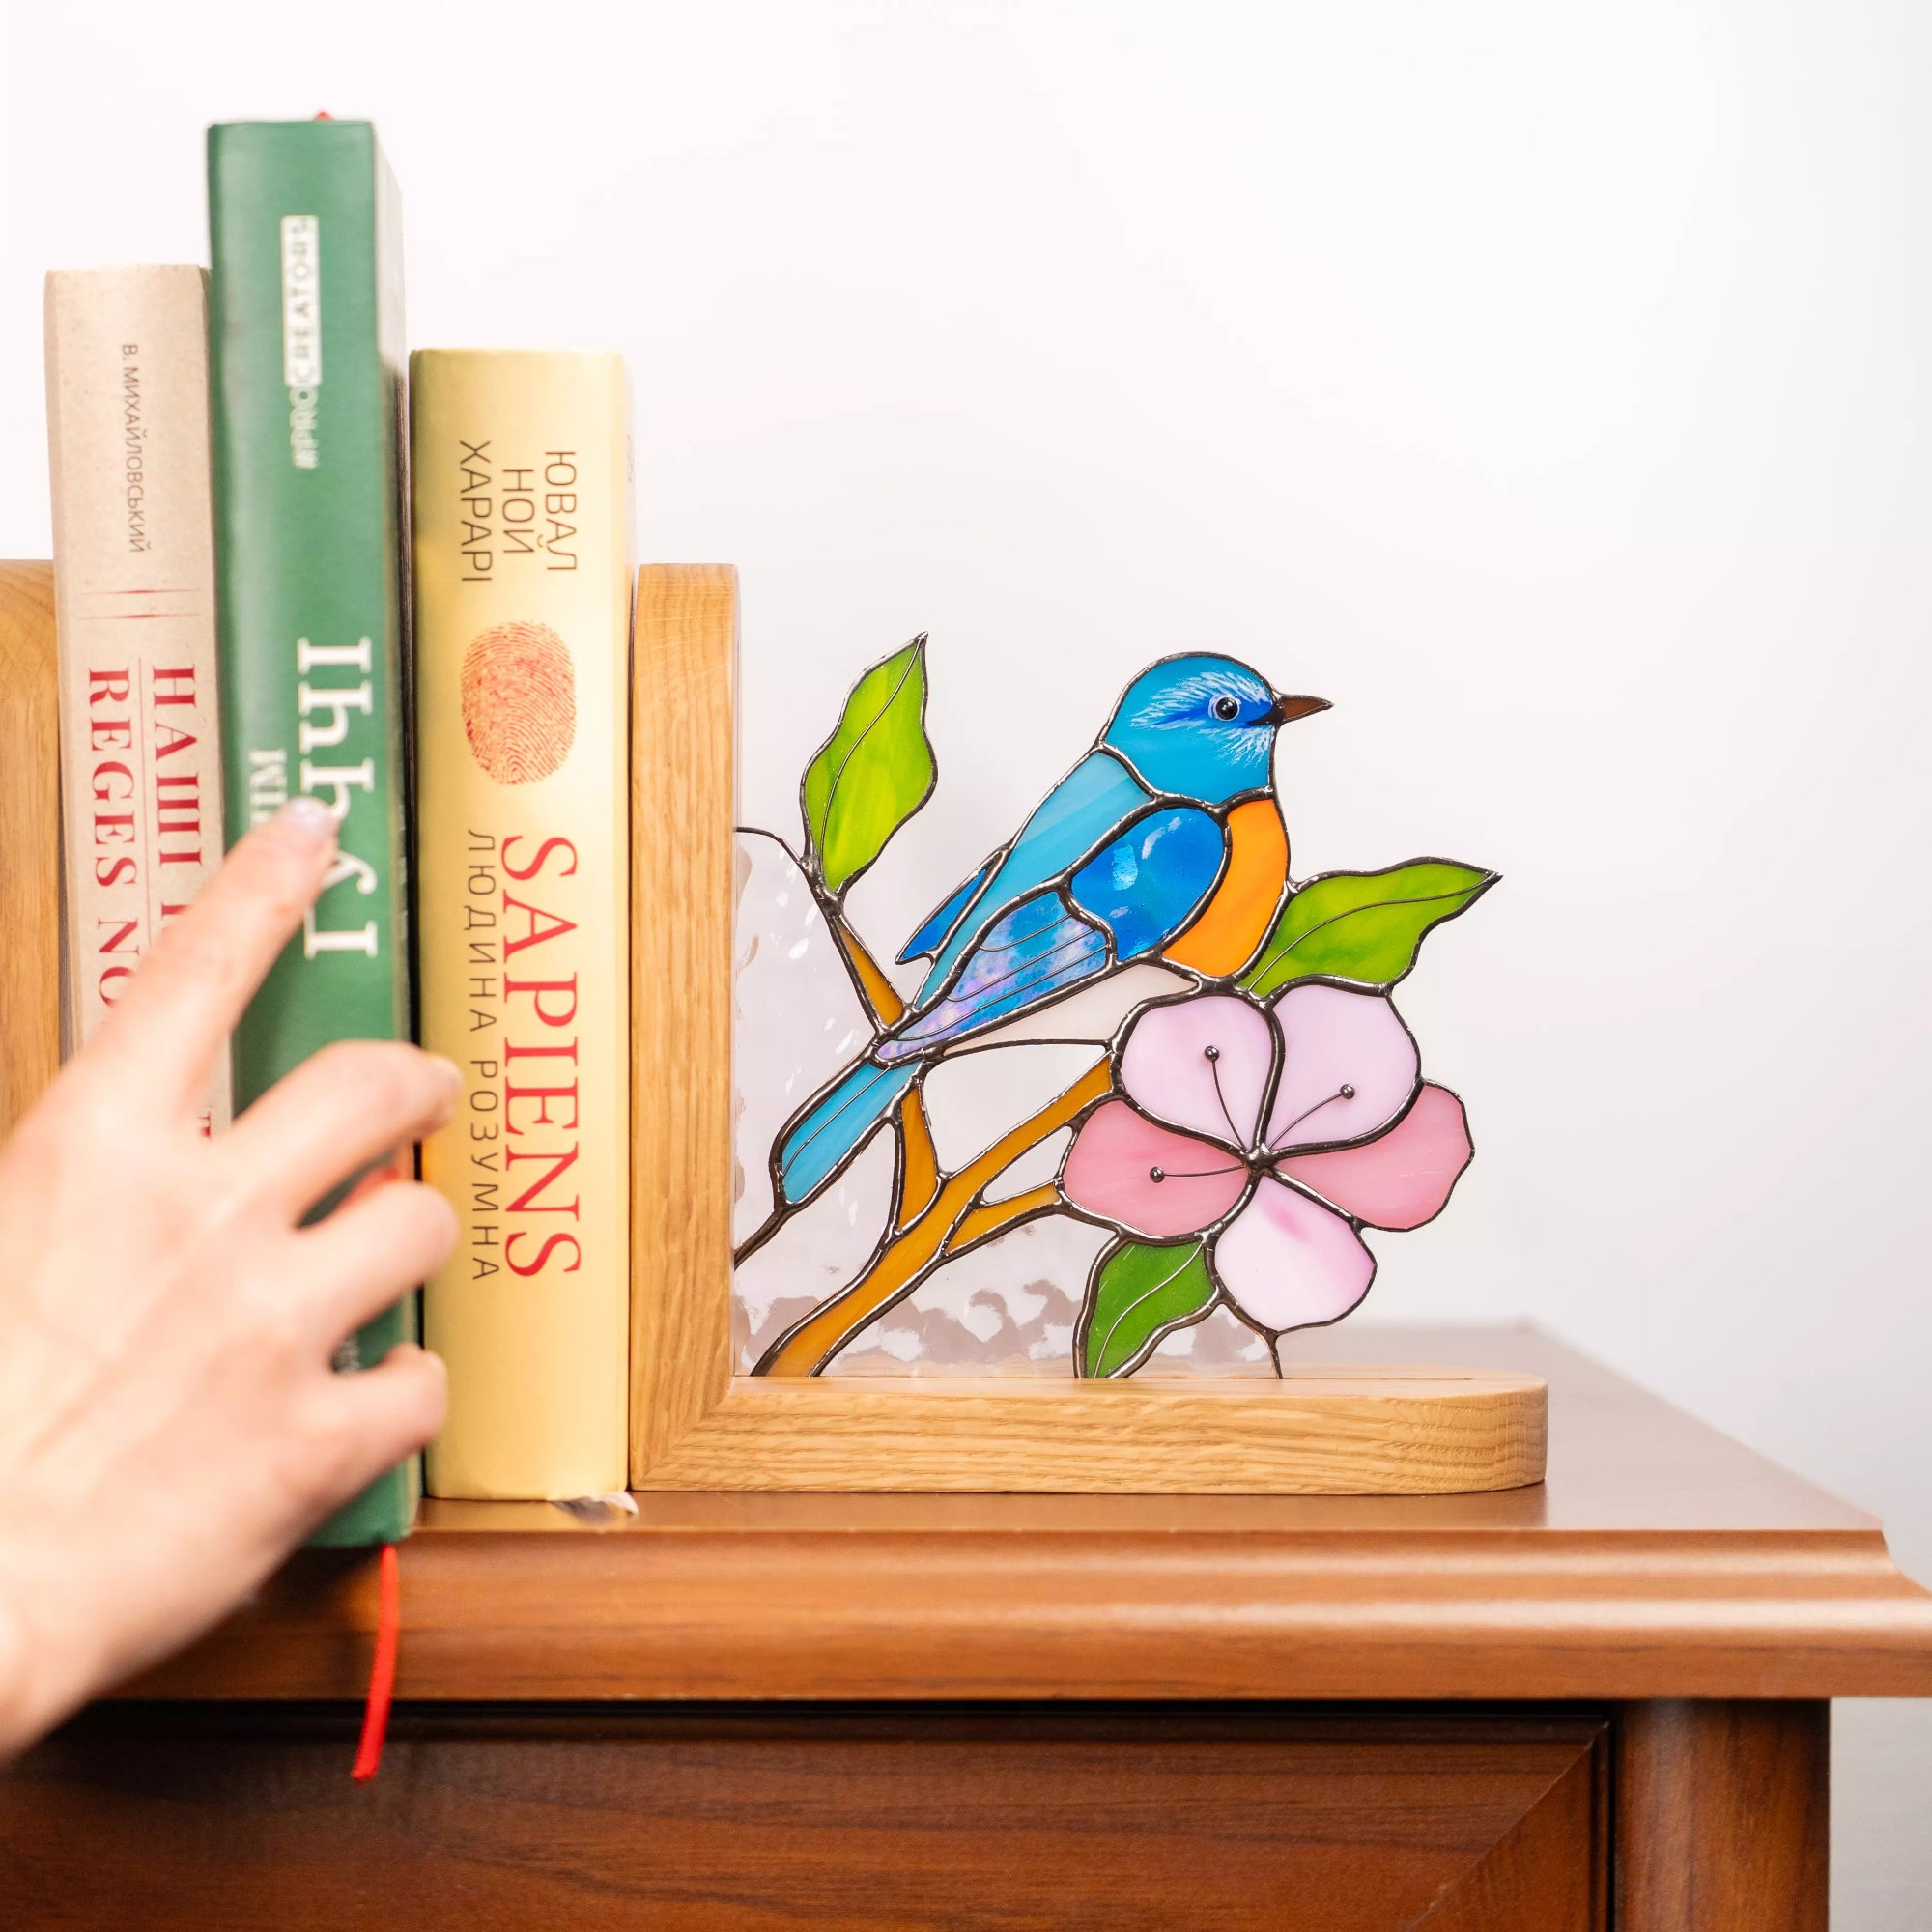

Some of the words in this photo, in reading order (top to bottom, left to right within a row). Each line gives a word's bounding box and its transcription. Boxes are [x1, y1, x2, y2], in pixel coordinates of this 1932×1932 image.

[122, 343, 138, 362] В.
[123, 366, 152, 553] МИХАЙЛОВСЬКИЙ
[460, 440, 493, 582] ХАРАРІ
[502, 469, 544, 554] НОЙ
[545, 451, 577, 571] ЮВАЛ
[88, 667, 137, 888] REGES
[153, 665, 202, 866] НАШІ
[463, 829, 497, 1033] ЛЮДИНА
[501, 835, 581, 1278] SAPIENS
[470, 1060, 500, 1280] РОЗУМНА
